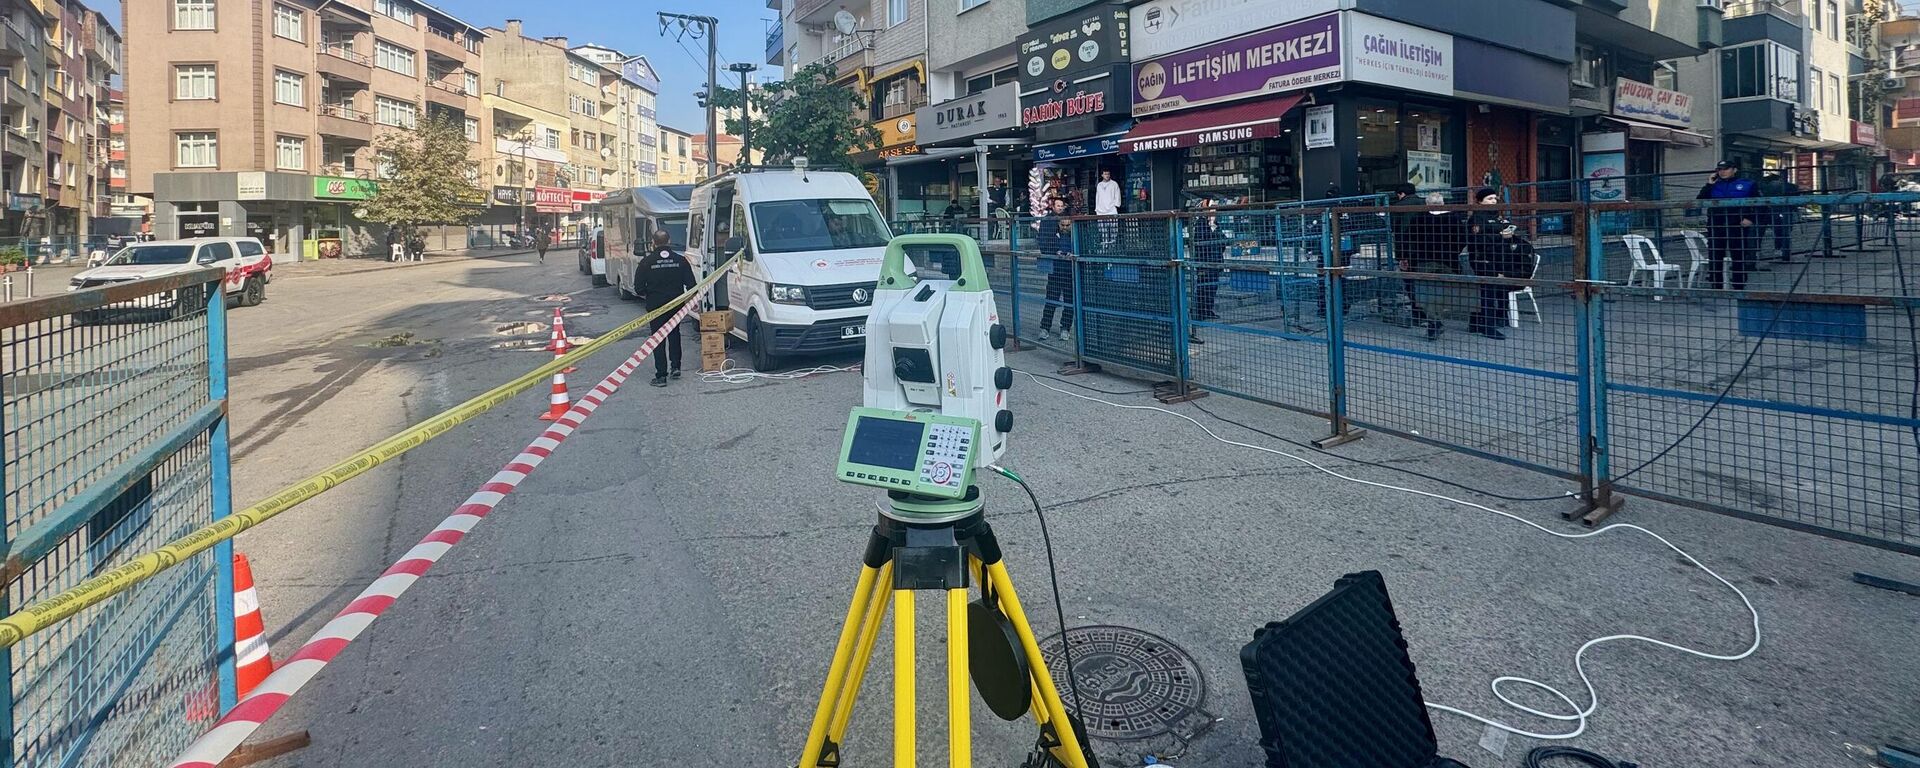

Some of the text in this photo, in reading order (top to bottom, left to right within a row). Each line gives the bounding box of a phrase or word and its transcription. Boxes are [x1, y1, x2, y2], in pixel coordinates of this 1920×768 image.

[1172, 24, 1333, 85] İLETİŞİM MERKEZİ
[1363, 33, 1443, 67] ÇAĞIN İLETİŞİM
[1139, 72, 1165, 92] ÇAĞIN
[1268, 80, 1291, 90] FATURA
[1291, 75, 1312, 86] ÖDEME
[1622, 81, 1654, 101] HUZUR
[1656, 90, 1673, 106] ÇAY
[936, 100, 987, 126] DURAK
[1023, 90, 1104, 128] ŞAHİN BÜFE
[1133, 138, 1178, 152] SAMSUNG
[1198, 127, 1253, 144] SAMSUNG
[536, 190, 564, 203] KÖFTECİ
[845, 327, 854, 336] 06
